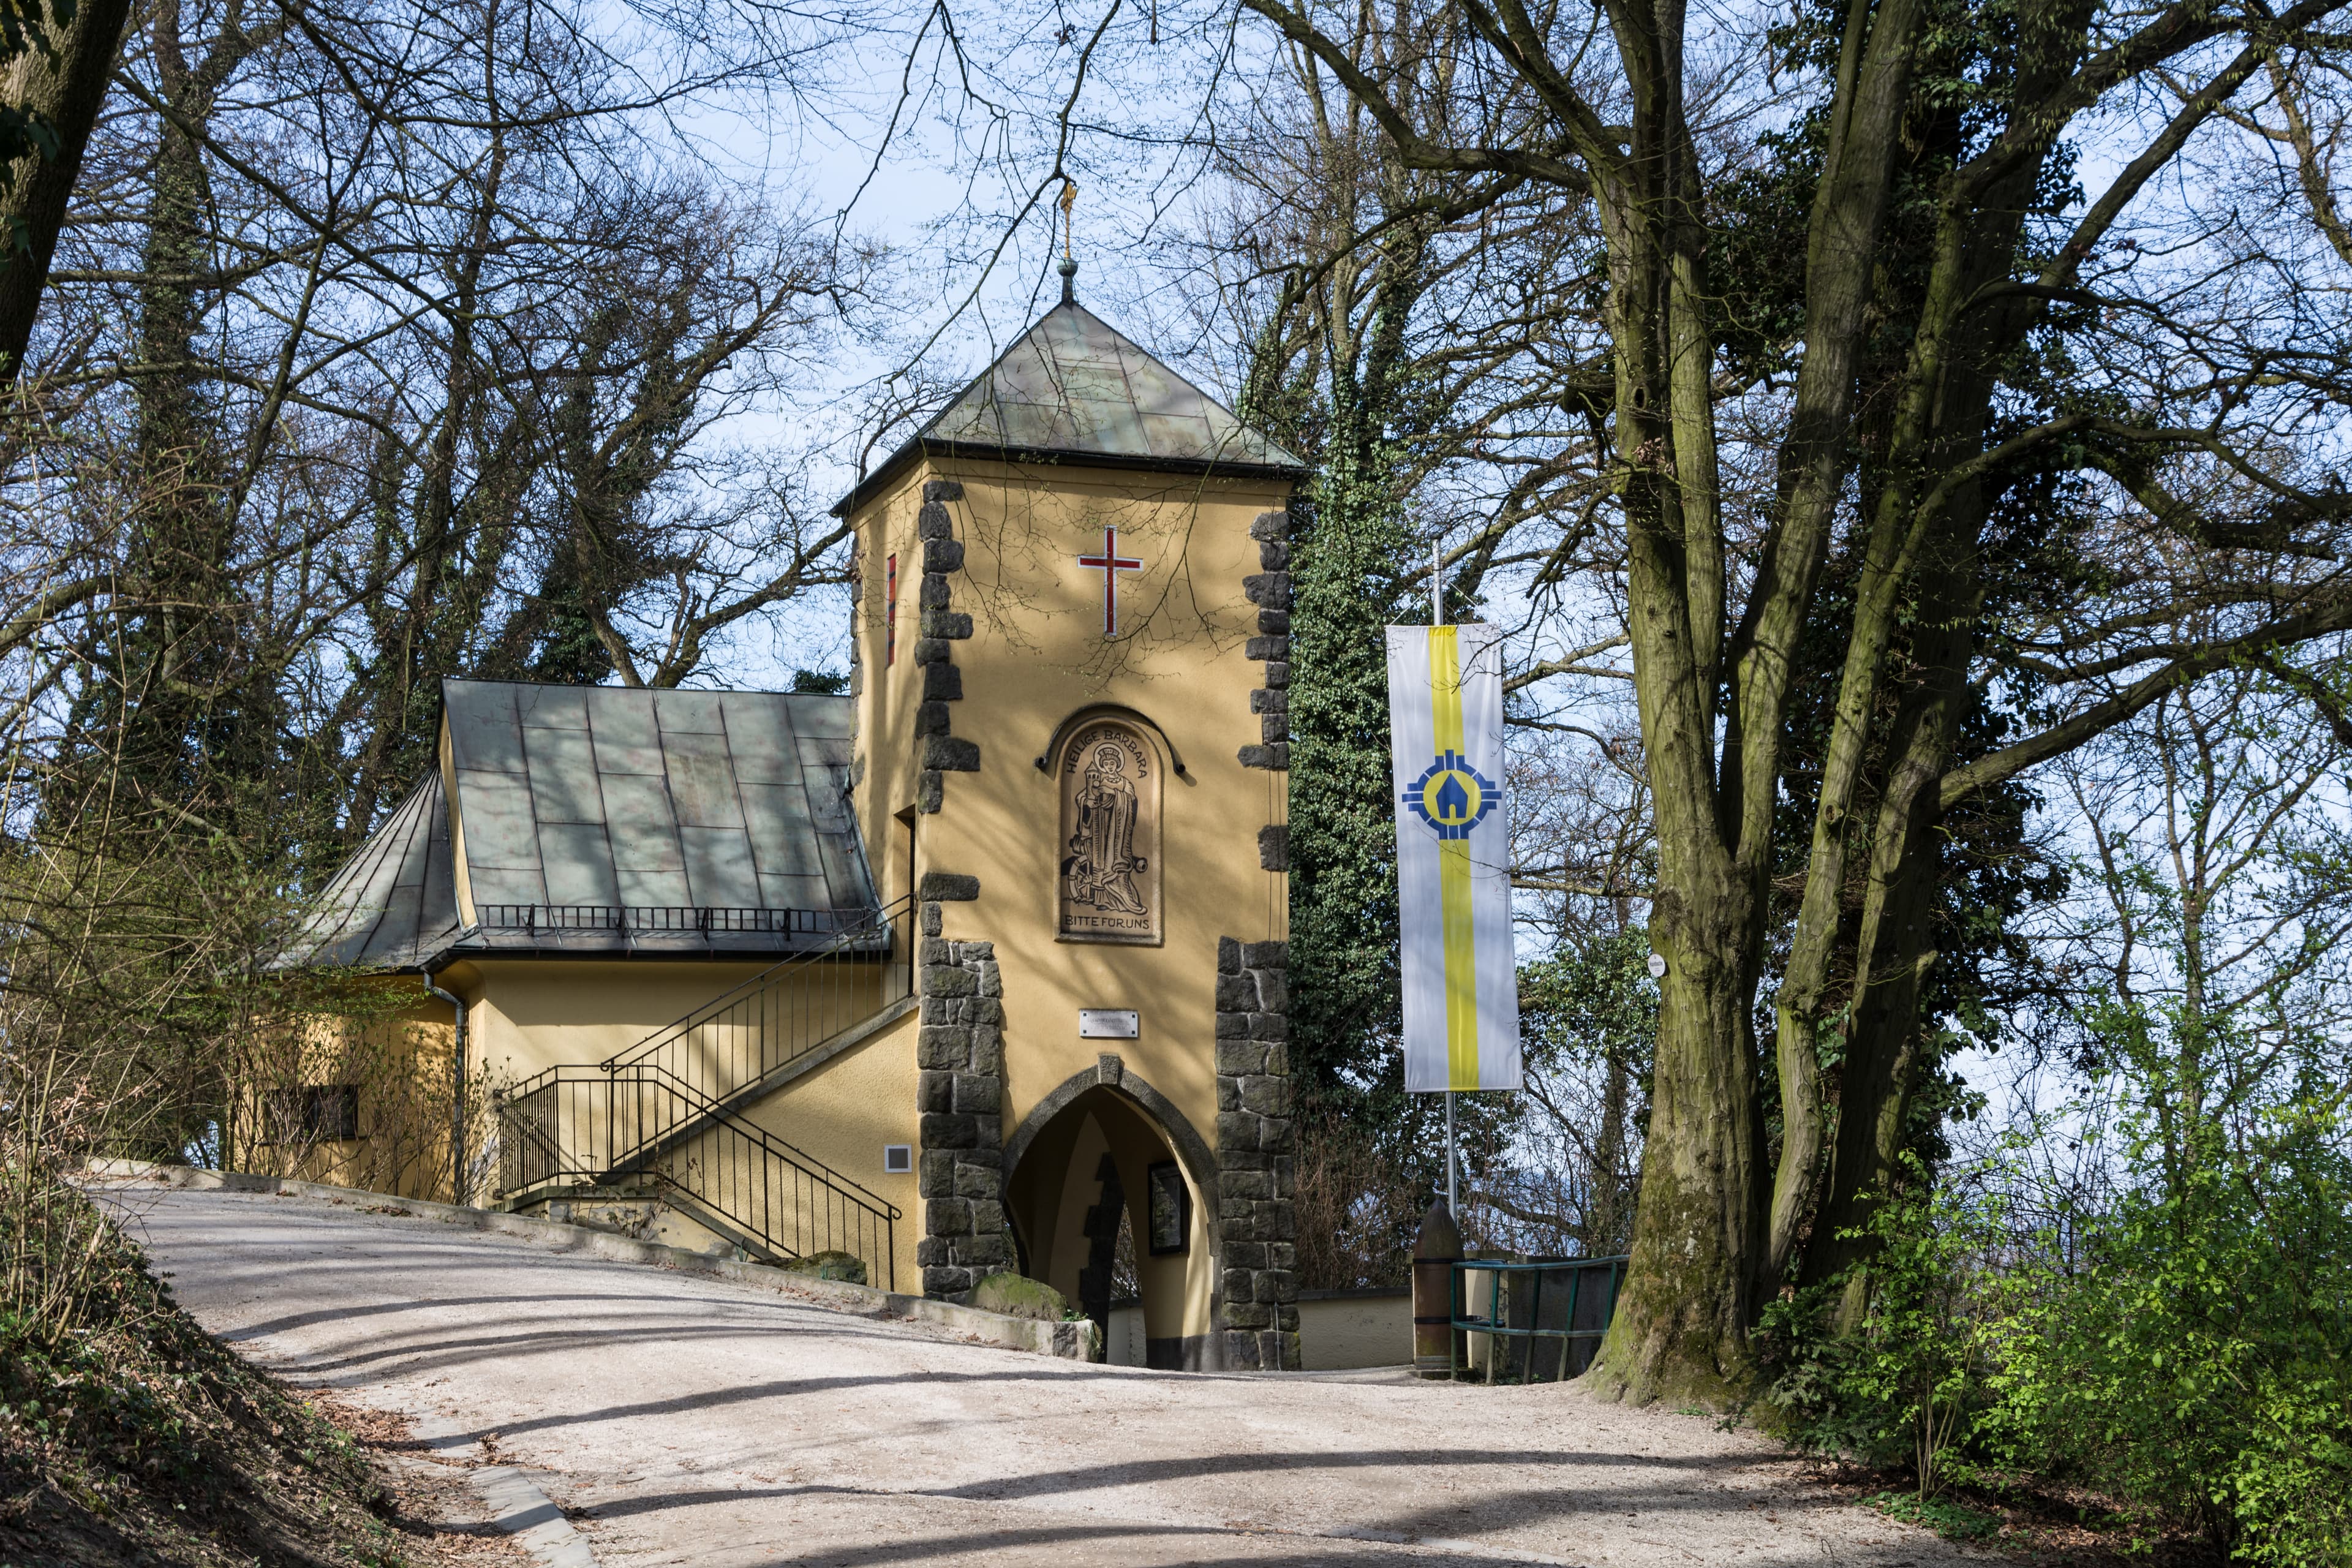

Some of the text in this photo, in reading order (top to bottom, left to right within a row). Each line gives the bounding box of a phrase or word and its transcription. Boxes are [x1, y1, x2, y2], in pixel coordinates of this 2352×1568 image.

[1066, 729, 1147, 779] HEILIGE BARBARA
[1065, 914, 1150, 930] BITTE FÜR UNS
